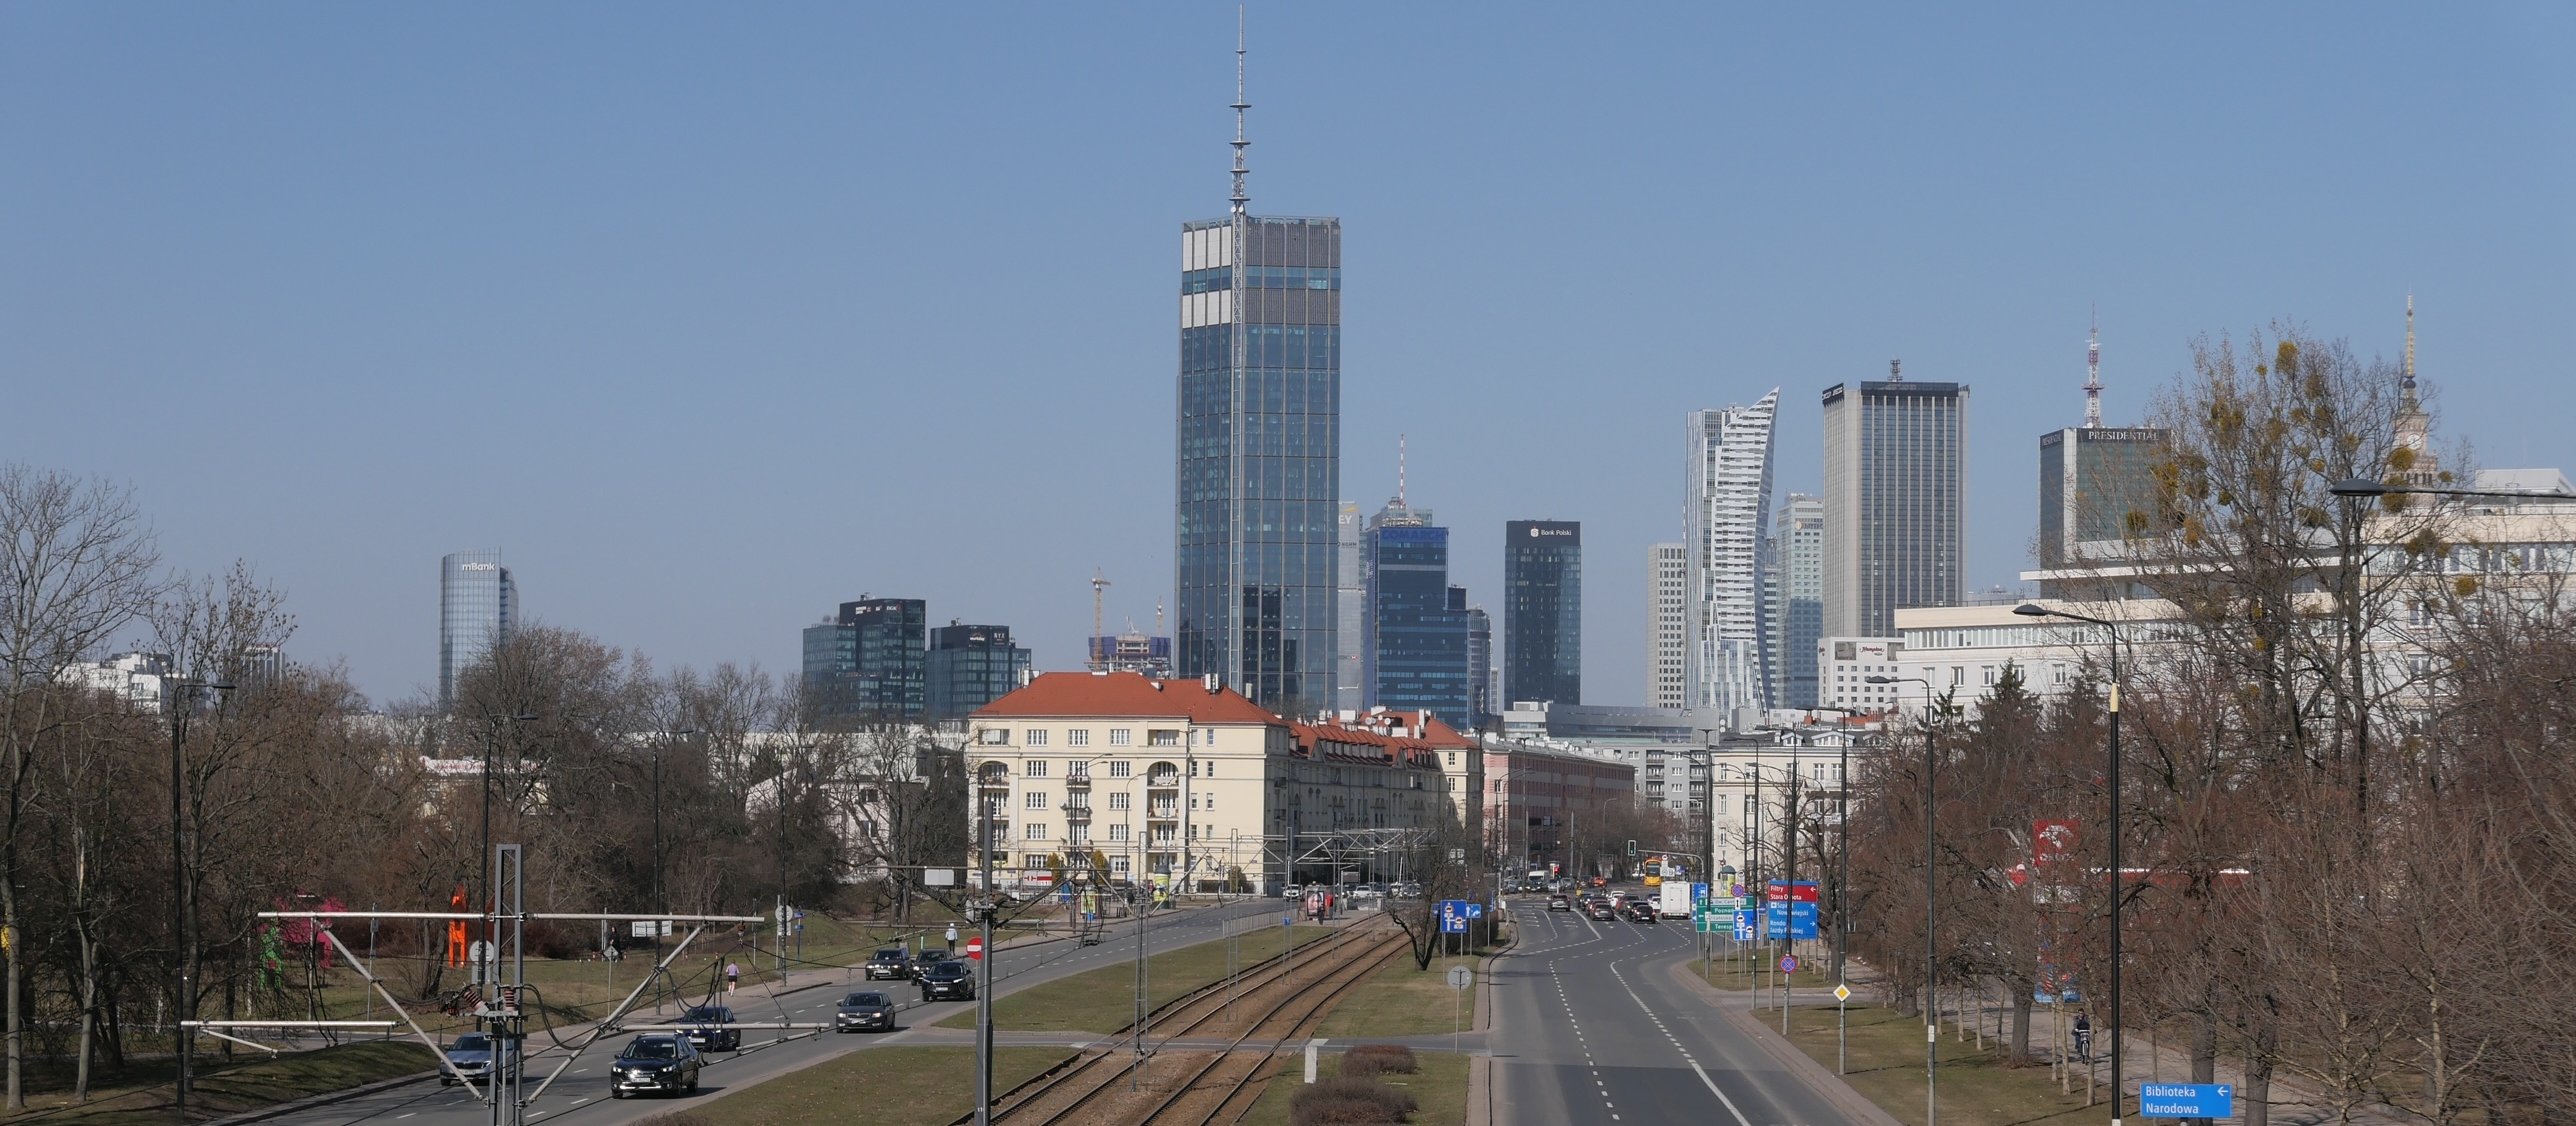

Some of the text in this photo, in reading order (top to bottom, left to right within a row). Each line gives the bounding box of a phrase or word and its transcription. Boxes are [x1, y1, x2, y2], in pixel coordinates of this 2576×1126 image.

[2088, 431, 2160, 441] PRESIDENTIAL
[462, 562, 496, 572] mBank
[1770, 885, 1784, 893] Filtry
[1776, 910, 1809, 918] Nowwiejski
[1714, 923, 1733, 931] Teresp
[2145, 1085, 2196, 1097] Biblioteka
[2146, 1102, 2199, 1114] Narodowa
